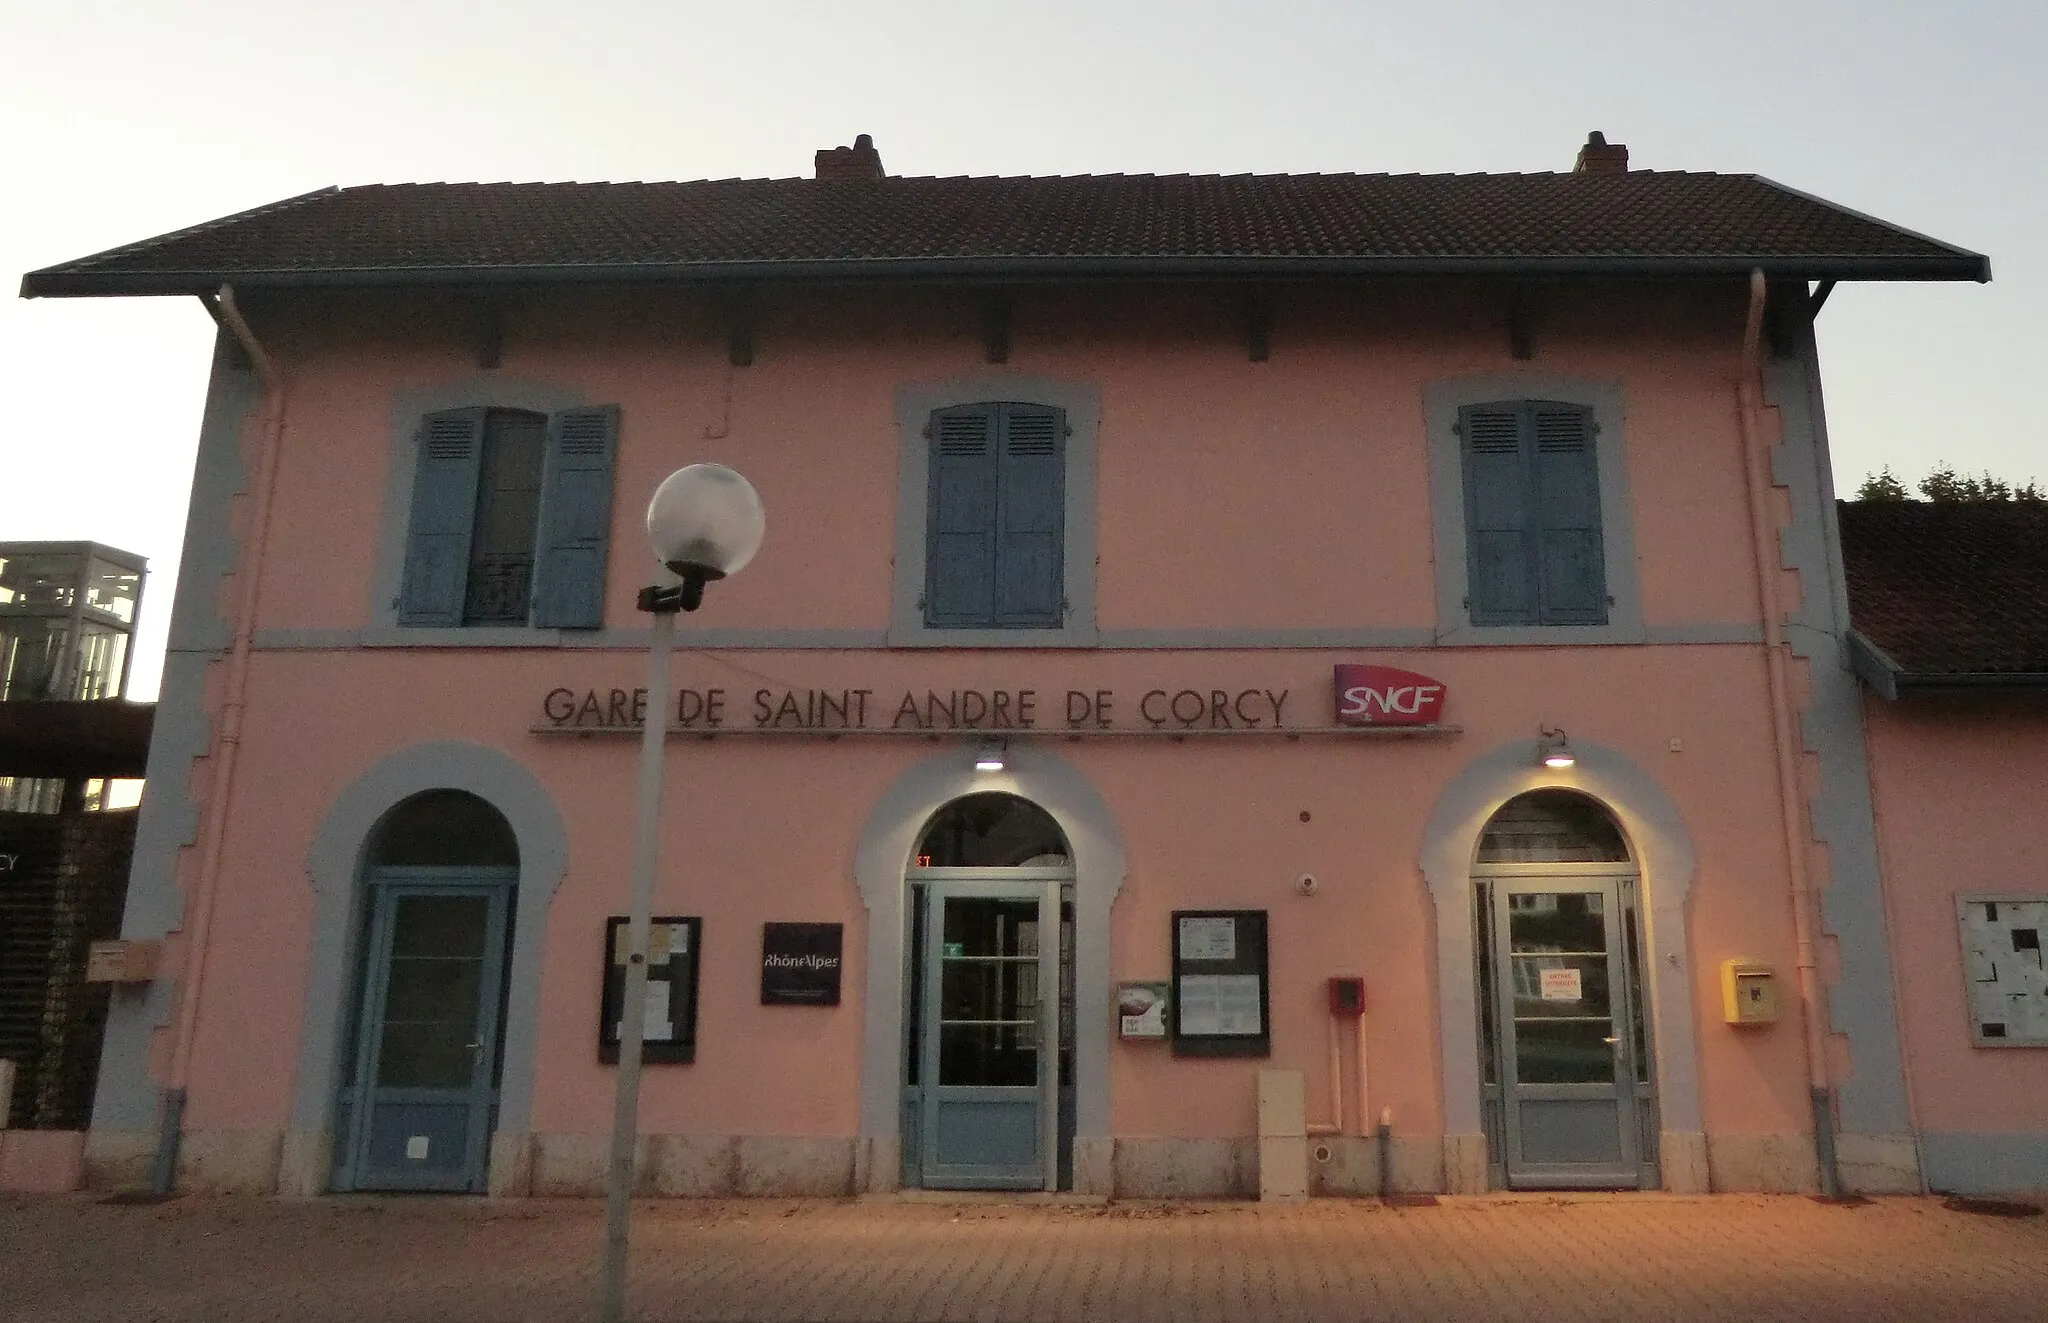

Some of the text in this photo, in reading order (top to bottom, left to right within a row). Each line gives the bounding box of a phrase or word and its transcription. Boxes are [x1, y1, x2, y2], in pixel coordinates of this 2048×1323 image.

[543, 687, 1289, 727] GARE DE SAINT ANDRE DE CORCY
[1340, 686, 1440, 714] SNCF
